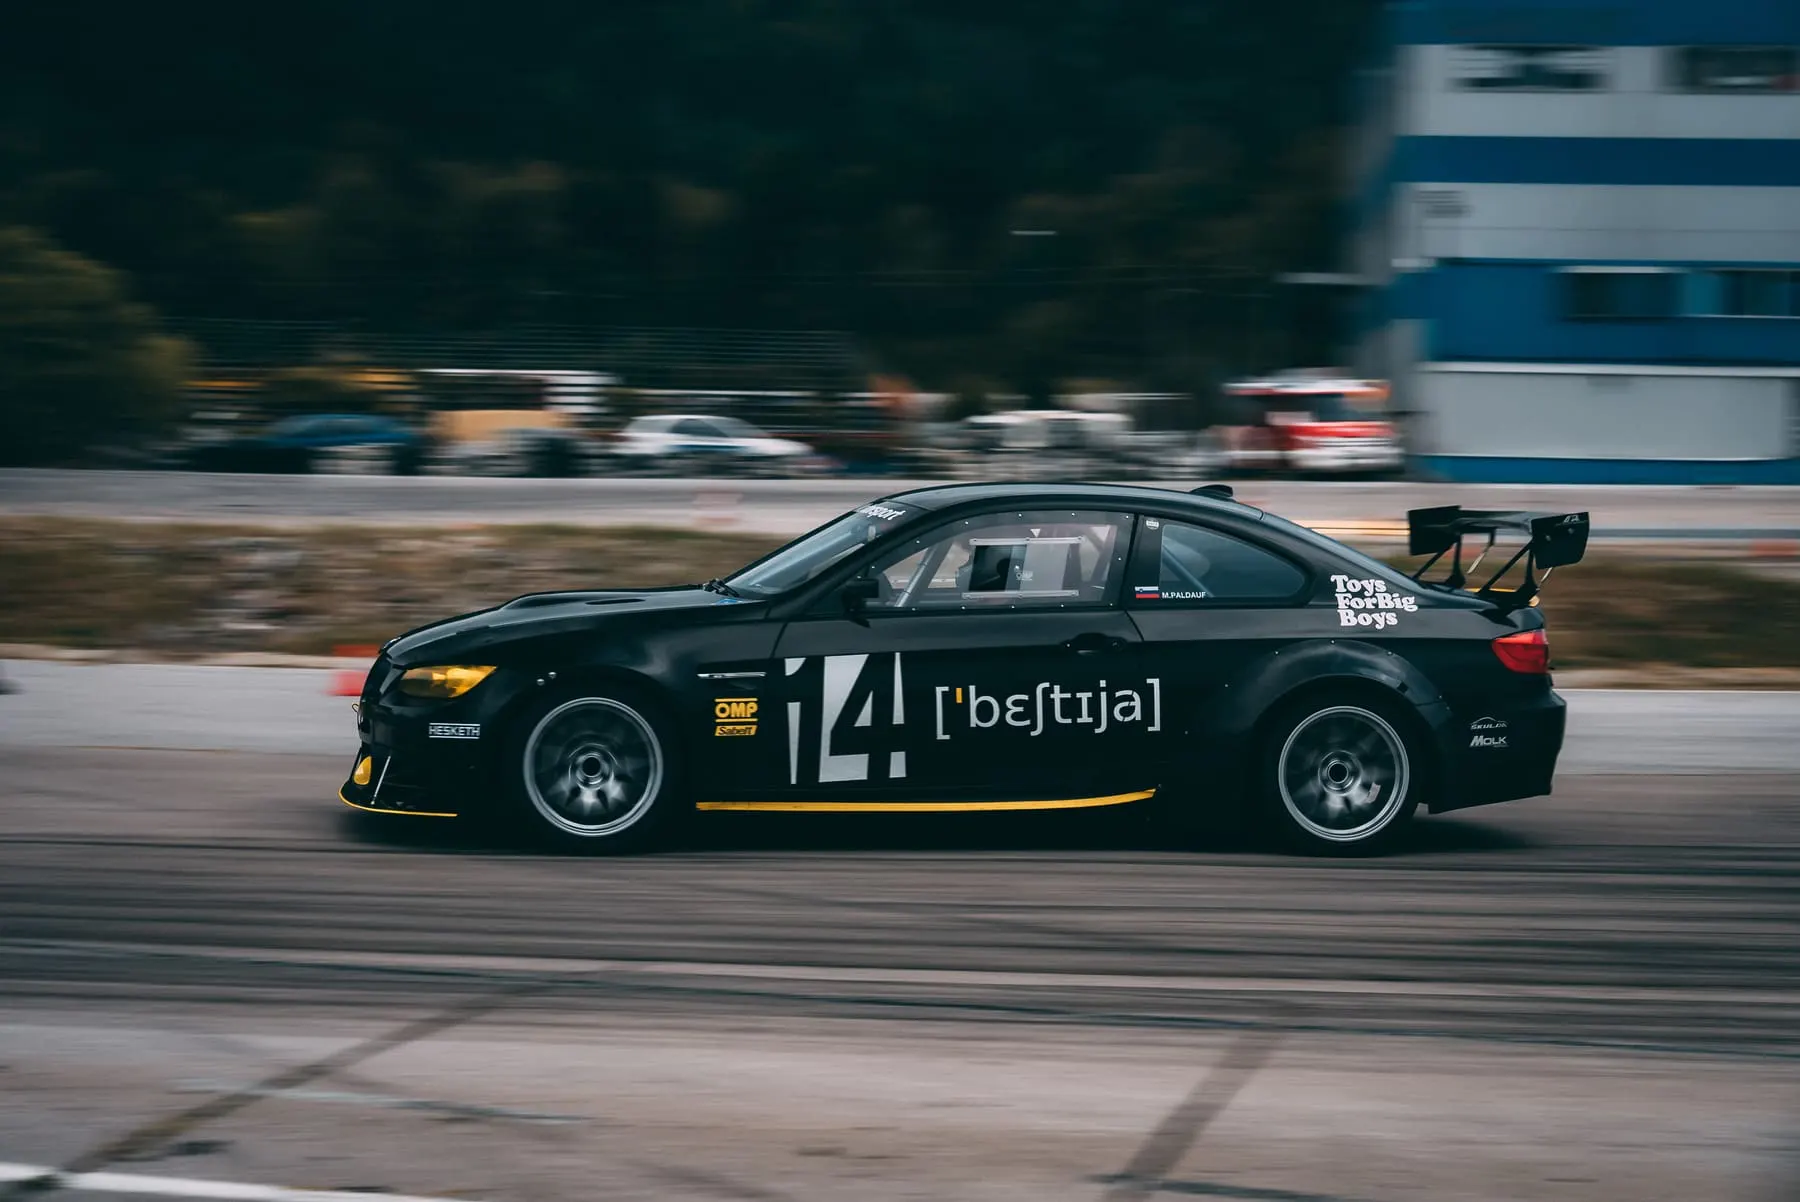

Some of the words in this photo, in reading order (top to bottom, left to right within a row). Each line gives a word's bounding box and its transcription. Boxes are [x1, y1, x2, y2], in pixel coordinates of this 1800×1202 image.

[1330, 574, 1387, 597] Toys
[1161, 591, 1206, 599] M.PALDAUF
[1337, 609, 1398, 629] Boys
[715, 702, 759, 718] OMP
[784, 652, 907, 785] 14
[428, 725, 481, 736] HESKETH
